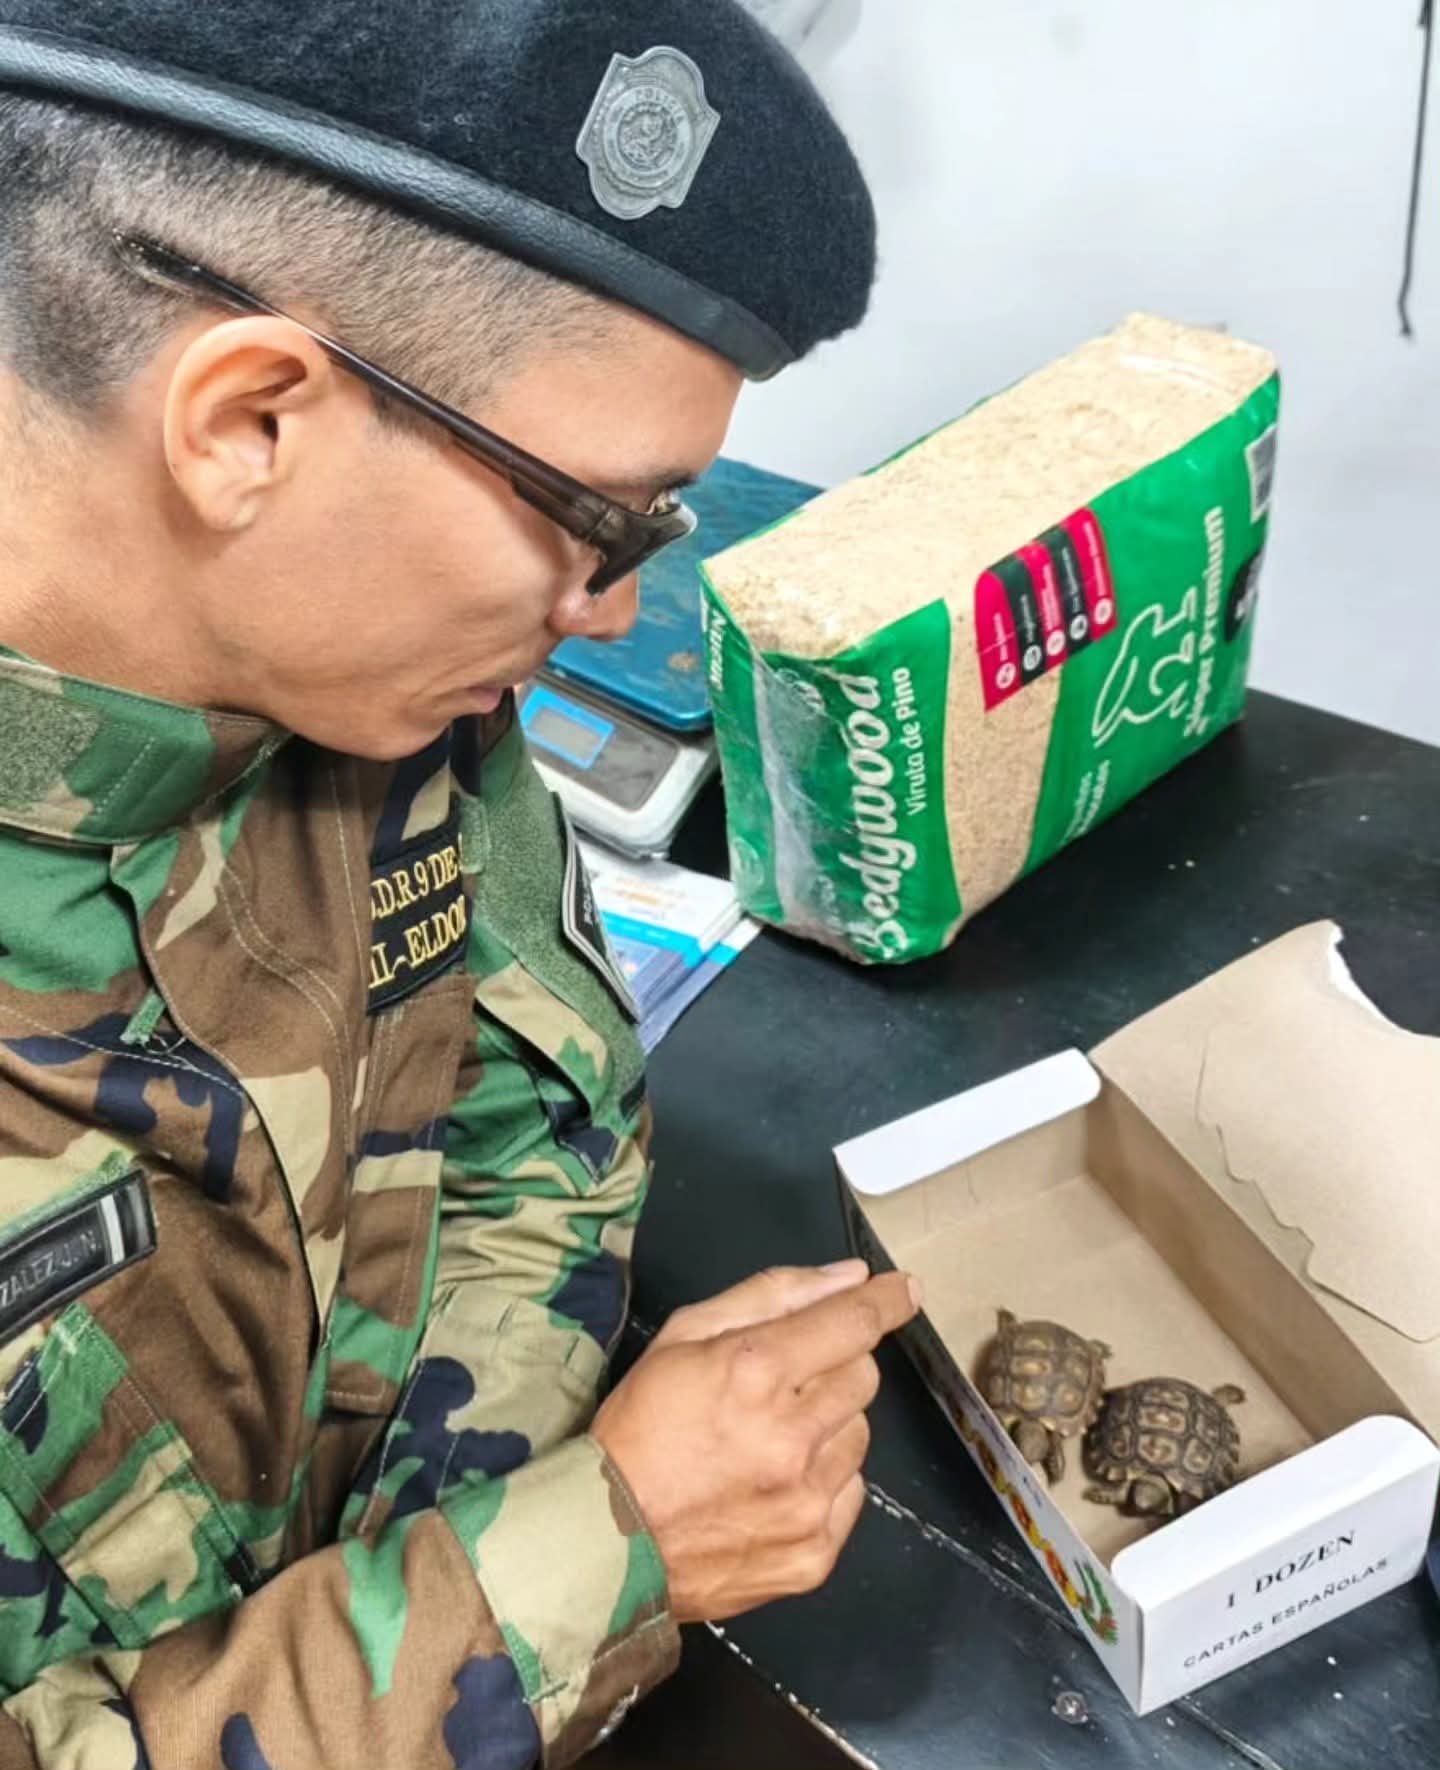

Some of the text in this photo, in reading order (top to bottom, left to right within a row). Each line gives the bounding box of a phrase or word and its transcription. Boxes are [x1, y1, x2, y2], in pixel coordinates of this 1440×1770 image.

[1200, 506, 1224, 655] Premium
[891, 667, 928, 816] Viruta de Pino
[1183, 1557, 1388, 1669] CARTAS ESPAÑOLAS
[1255, 1530, 1356, 1594] DOZEN
